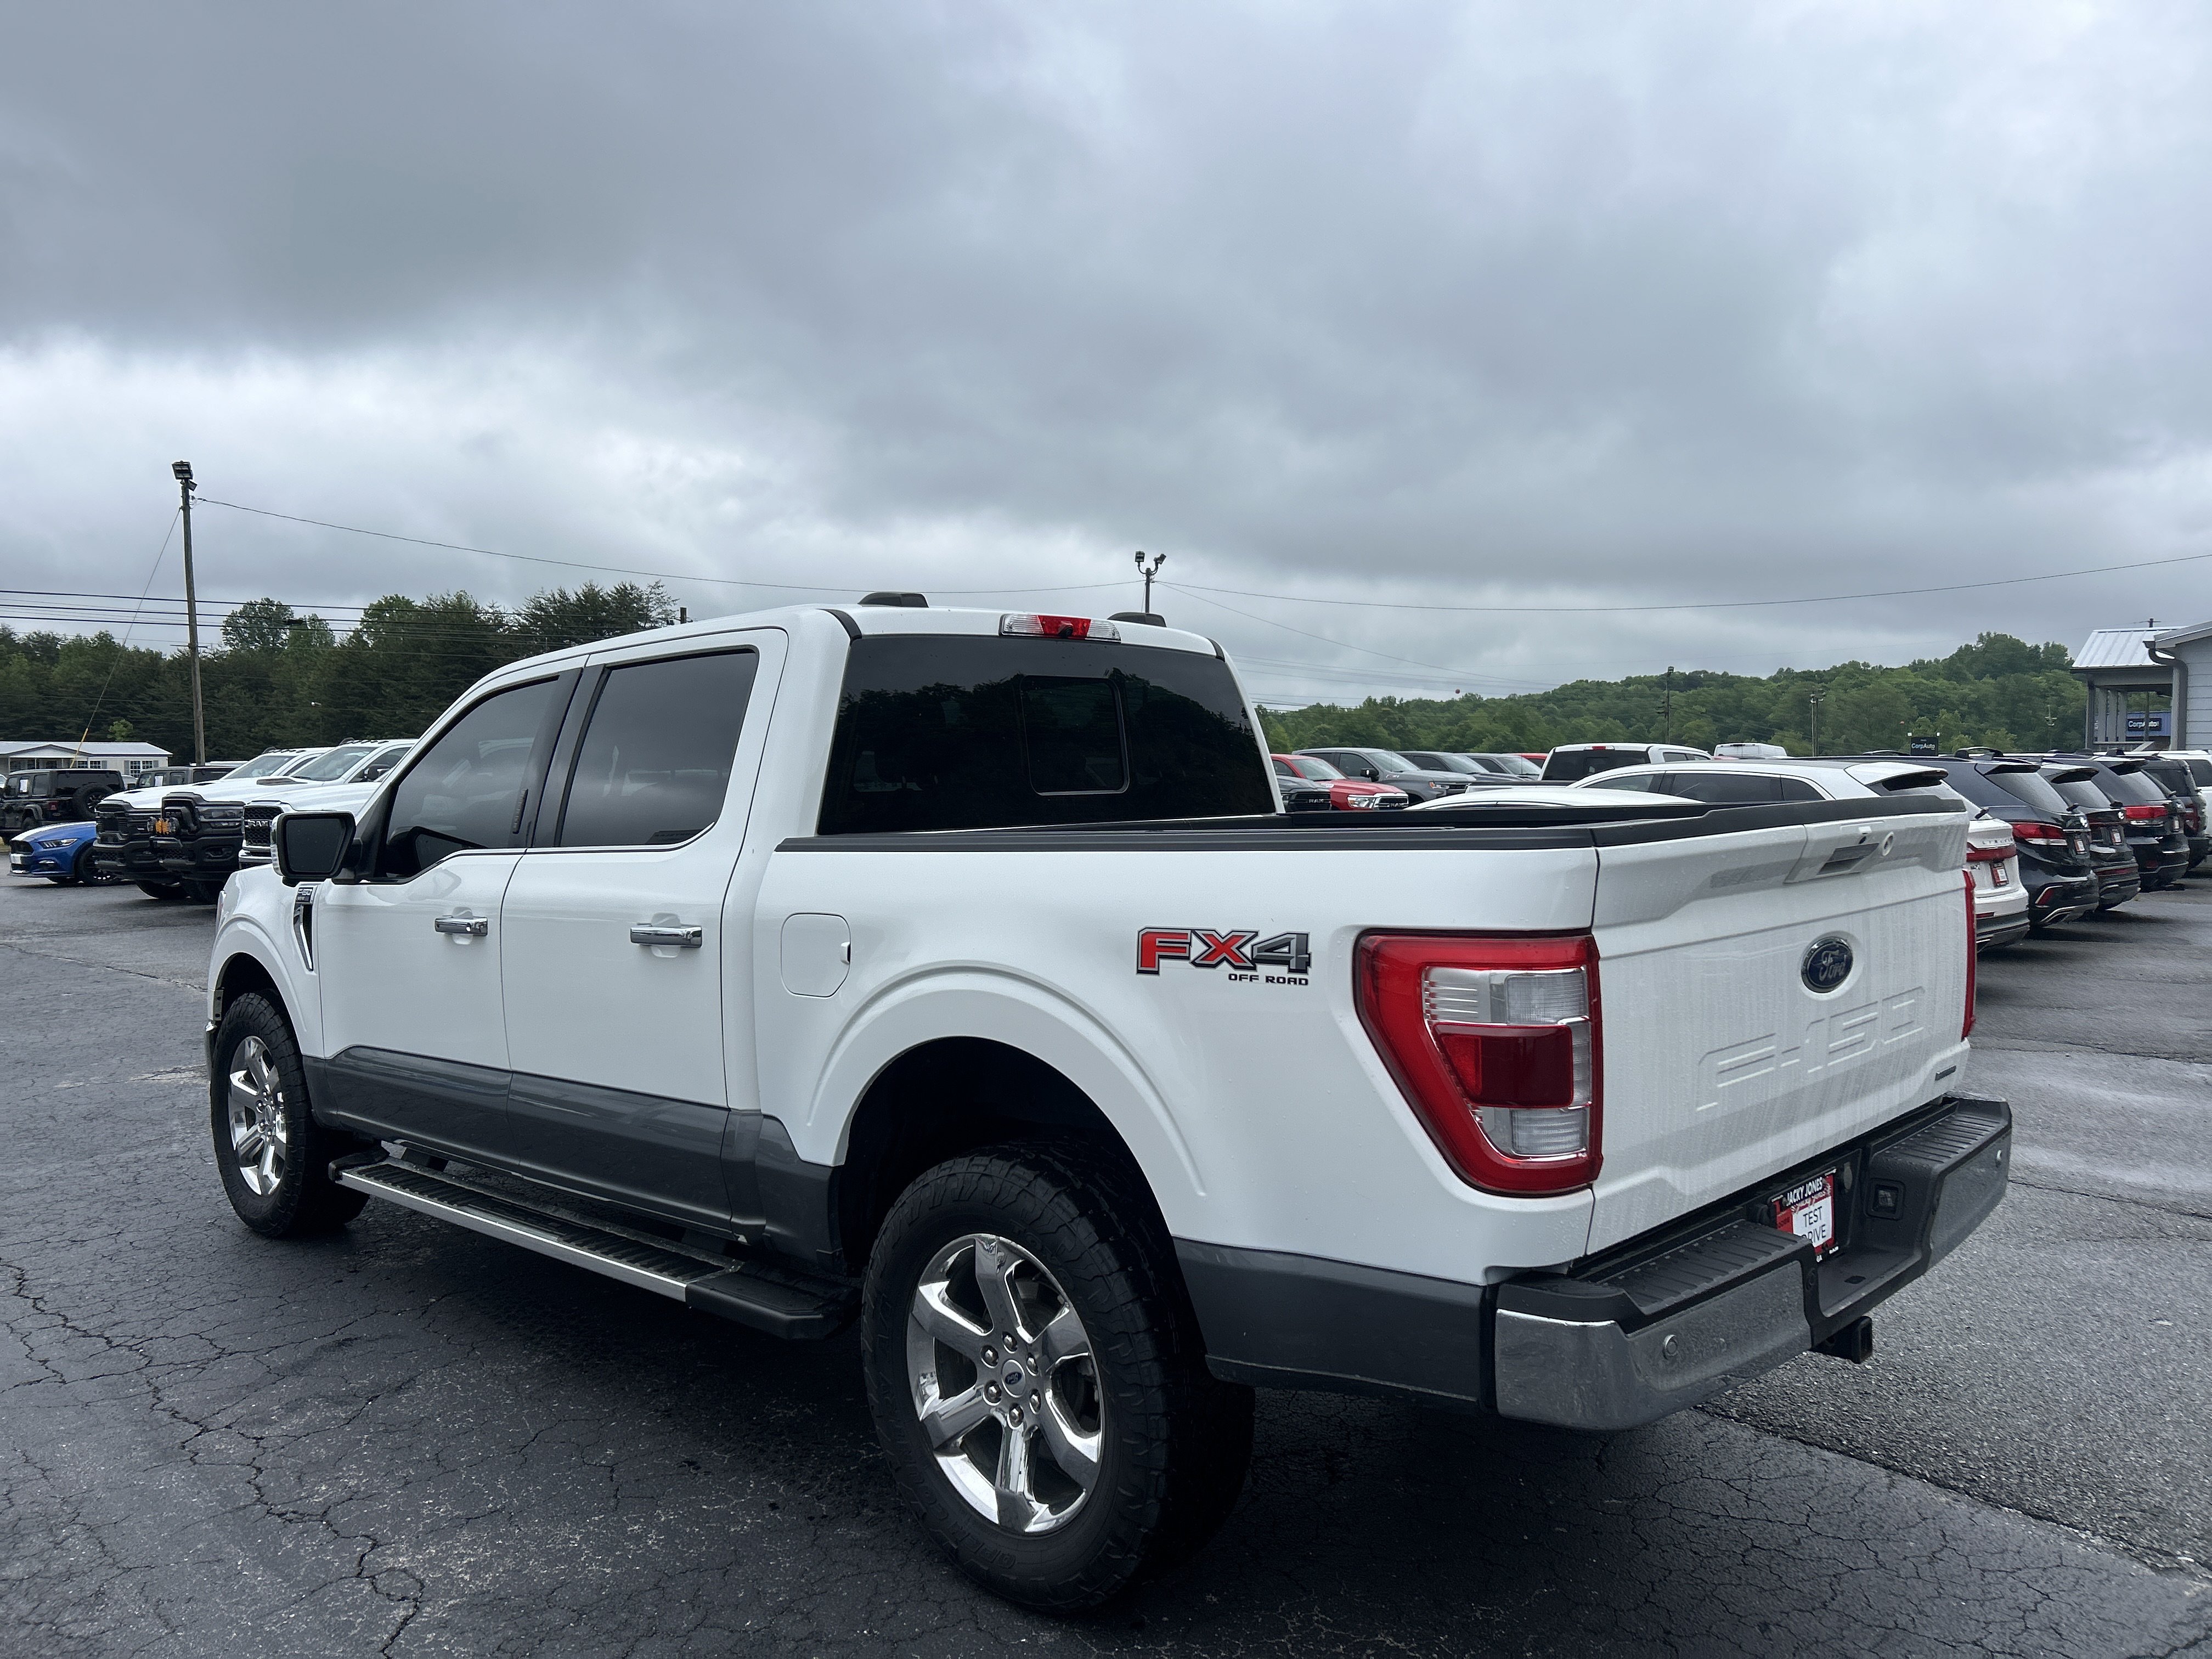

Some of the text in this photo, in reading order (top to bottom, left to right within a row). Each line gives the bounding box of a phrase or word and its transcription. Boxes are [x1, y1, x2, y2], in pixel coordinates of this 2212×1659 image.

[1137, 927, 1312, 975] FX4
[1819, 950, 1847, 981] Ford
[1228, 973, 1308, 985] OFF ROAD
[1786, 1186, 1804, 1206] JACKY
[1805, 1177, 1822, 1197] JONES
[1803, 1206, 1822, 1227] TEST
